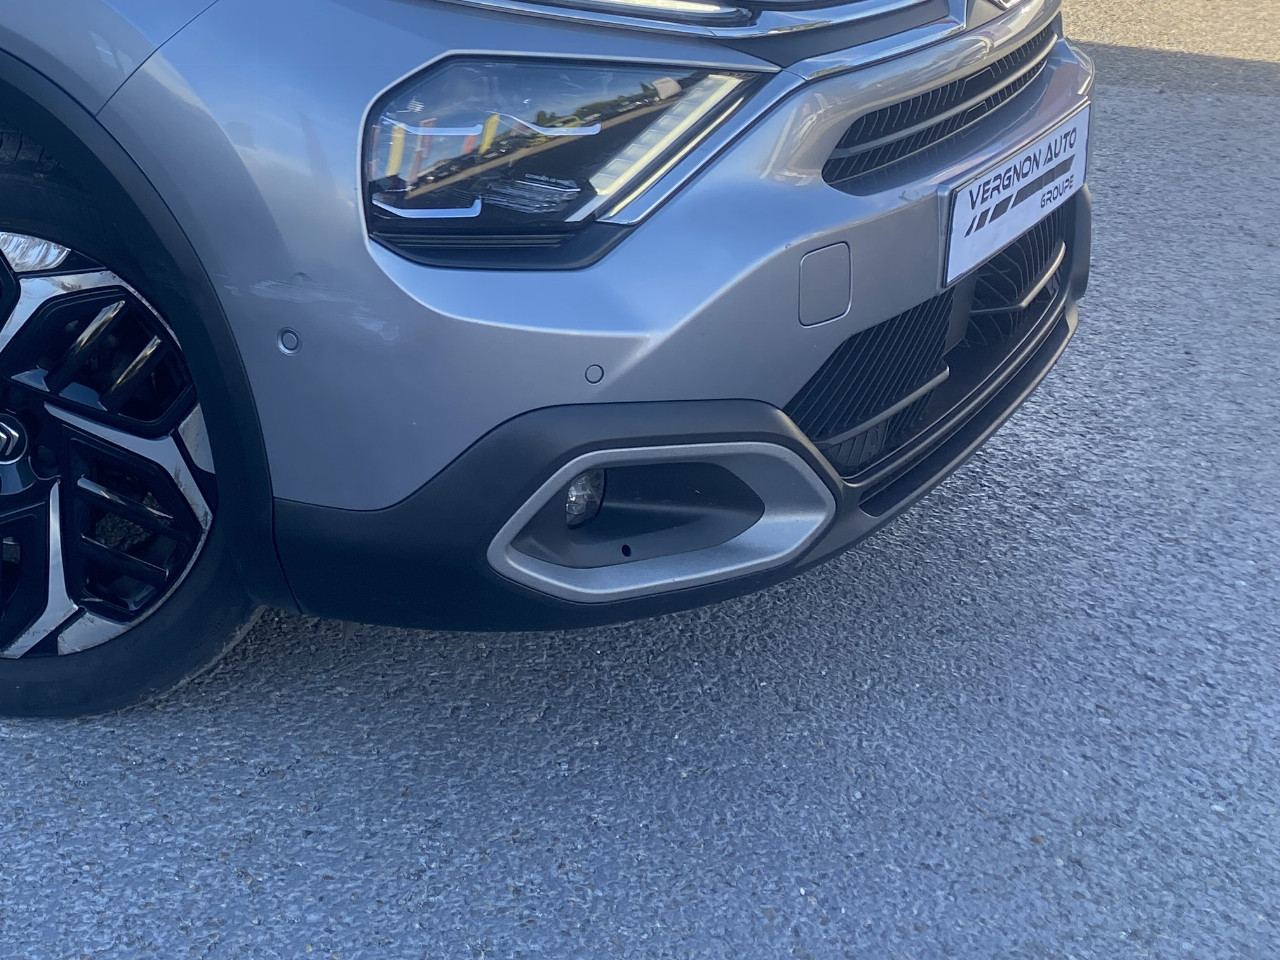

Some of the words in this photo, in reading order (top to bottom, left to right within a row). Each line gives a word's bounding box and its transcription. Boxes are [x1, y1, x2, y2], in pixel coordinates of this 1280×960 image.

[968, 148, 1042, 211] VERGNON
[1044, 128, 1077, 165] AUTO
[1040, 174, 1075, 209] GROUPE
